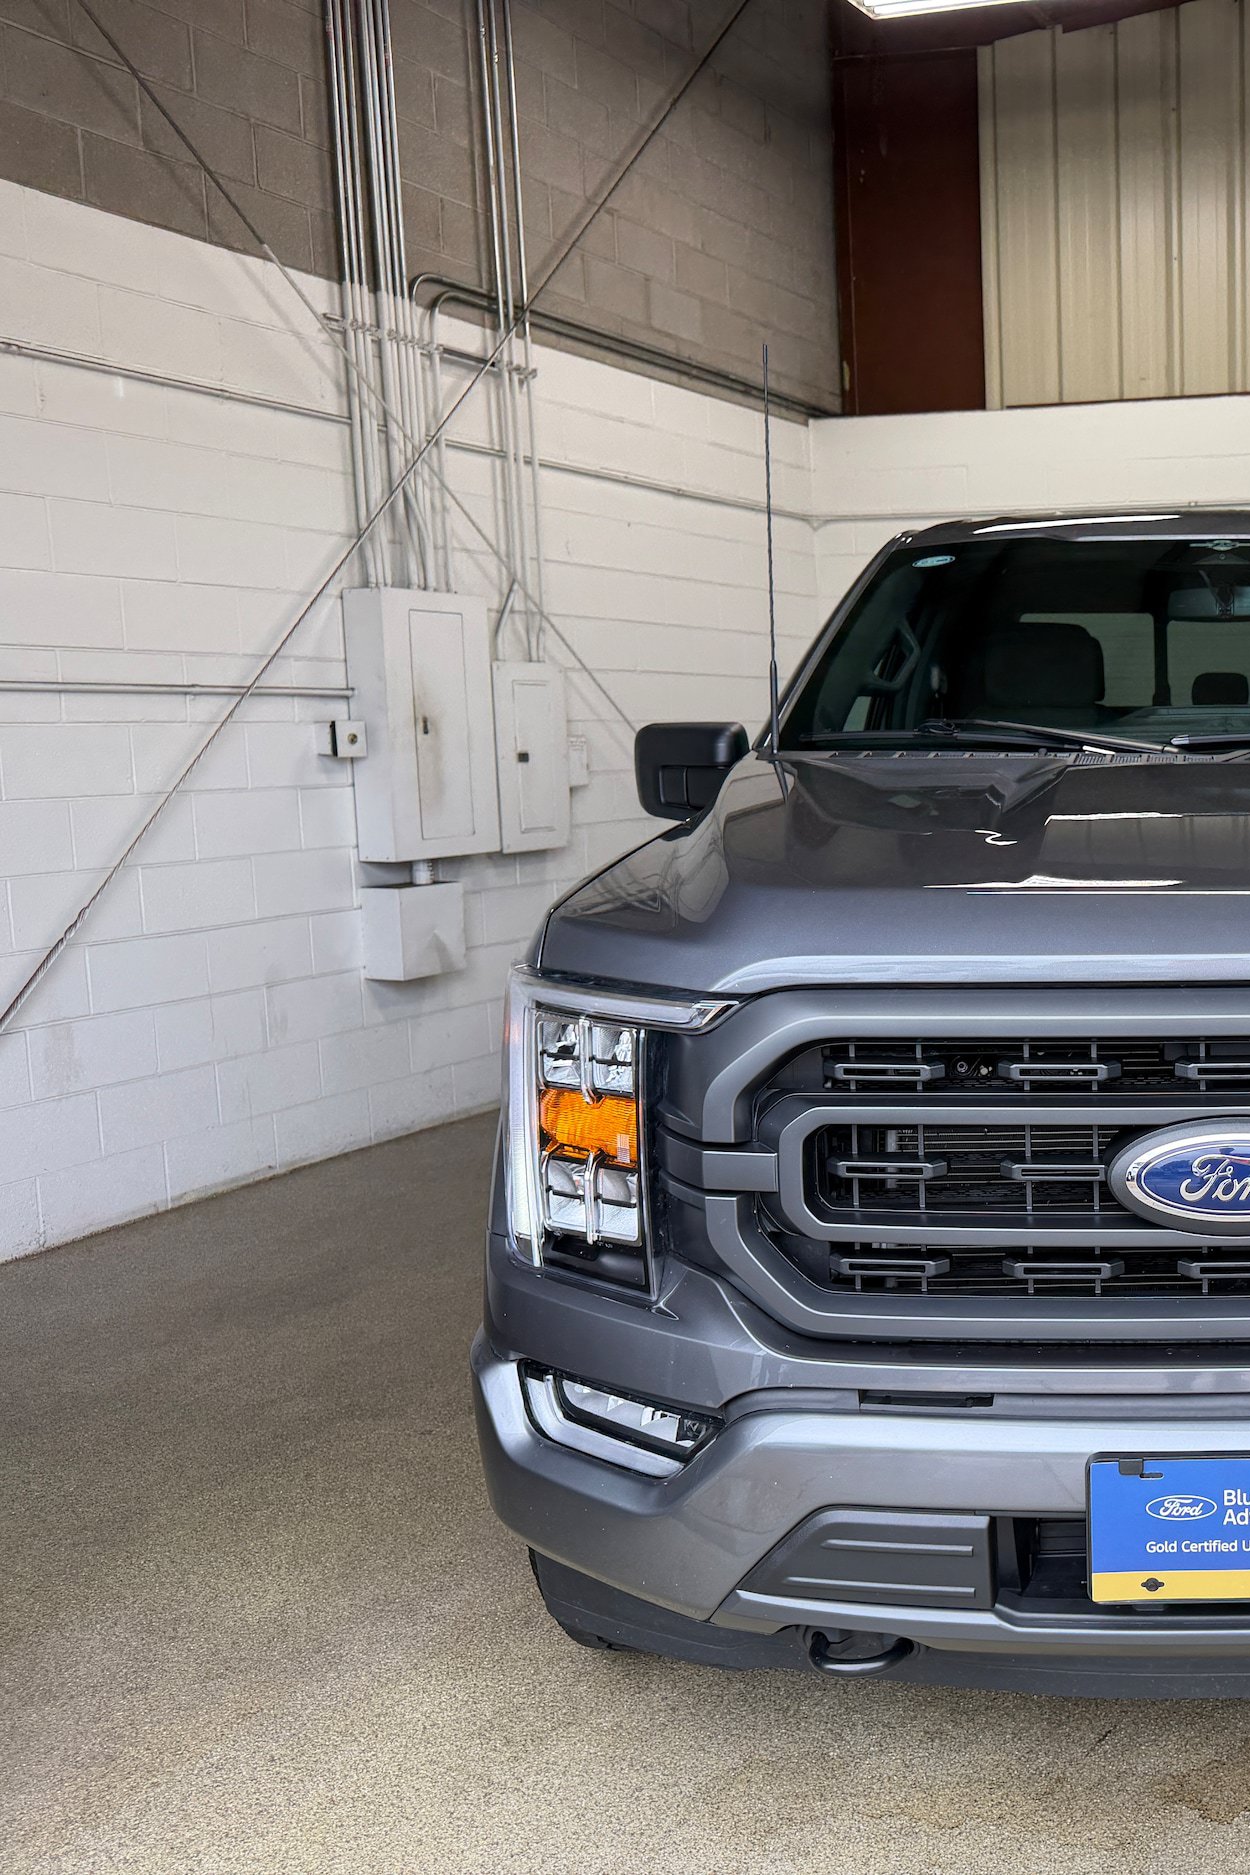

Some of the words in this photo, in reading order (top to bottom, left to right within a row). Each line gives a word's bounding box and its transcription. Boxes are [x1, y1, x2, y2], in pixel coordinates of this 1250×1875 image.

[1159, 1498, 1204, 1517] Ford
[1146, 1541, 1178, 1554] Gold
[1181, 1540, 1238, 1553] Certified
